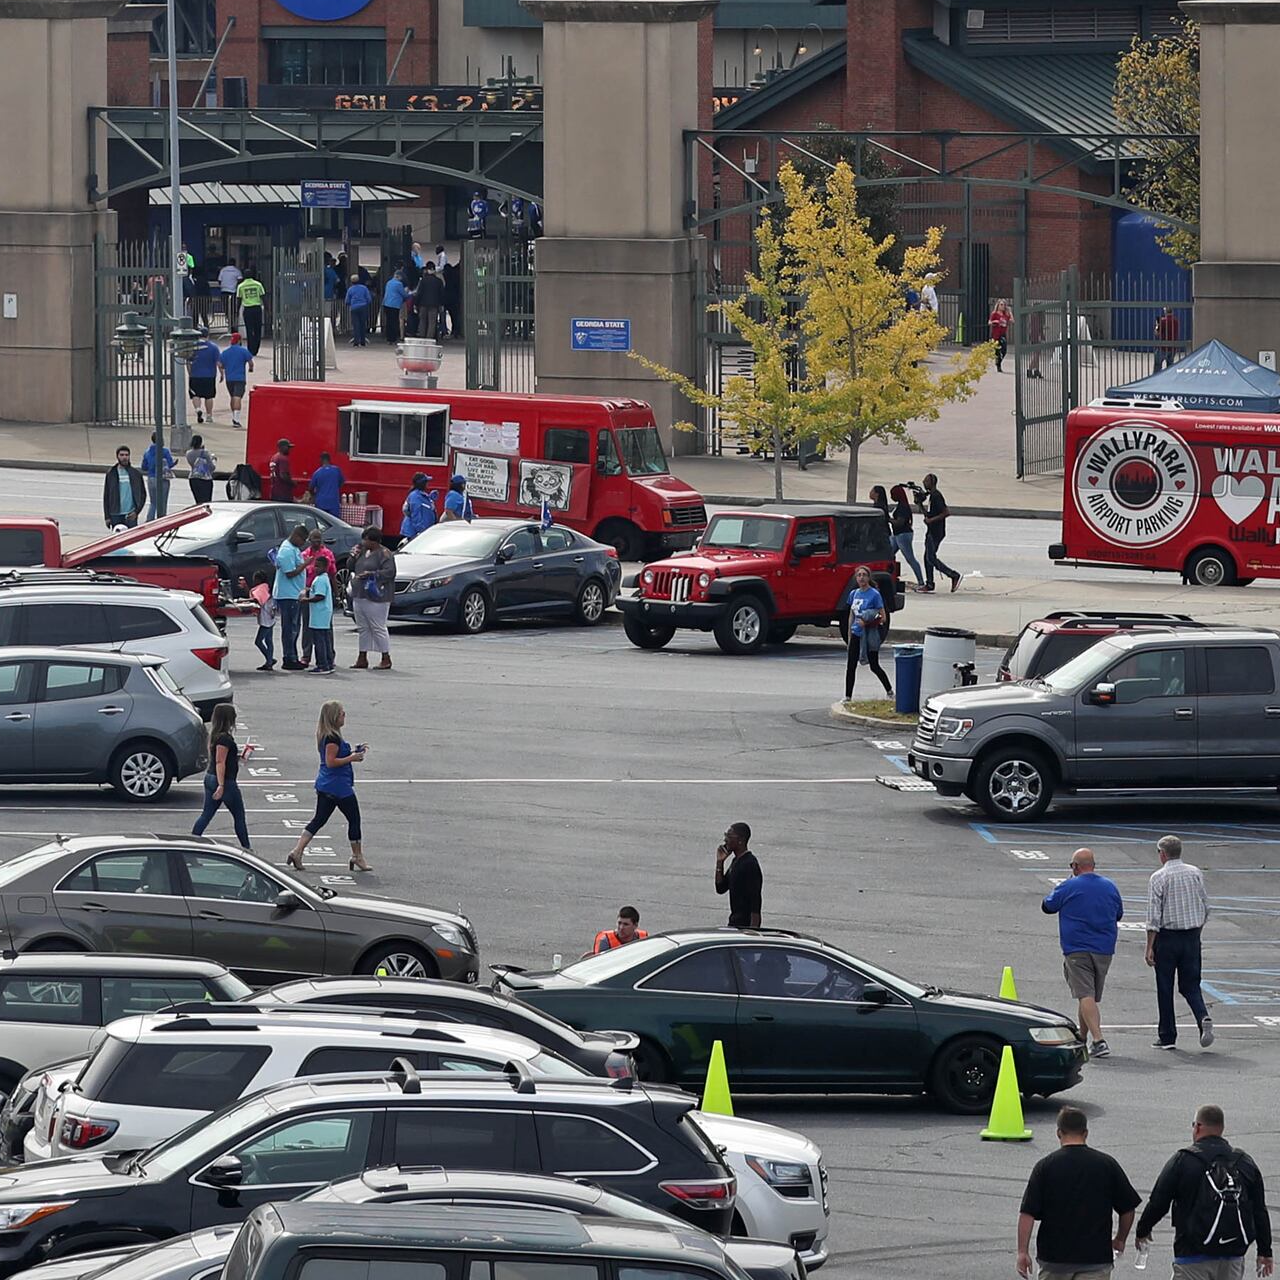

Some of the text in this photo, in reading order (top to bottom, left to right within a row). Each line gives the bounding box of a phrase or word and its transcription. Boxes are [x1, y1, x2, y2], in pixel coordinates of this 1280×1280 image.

[1086, 430, 1187, 478] WALLYPARK
[1087, 492, 1185, 536] AIRPORT PARKING
